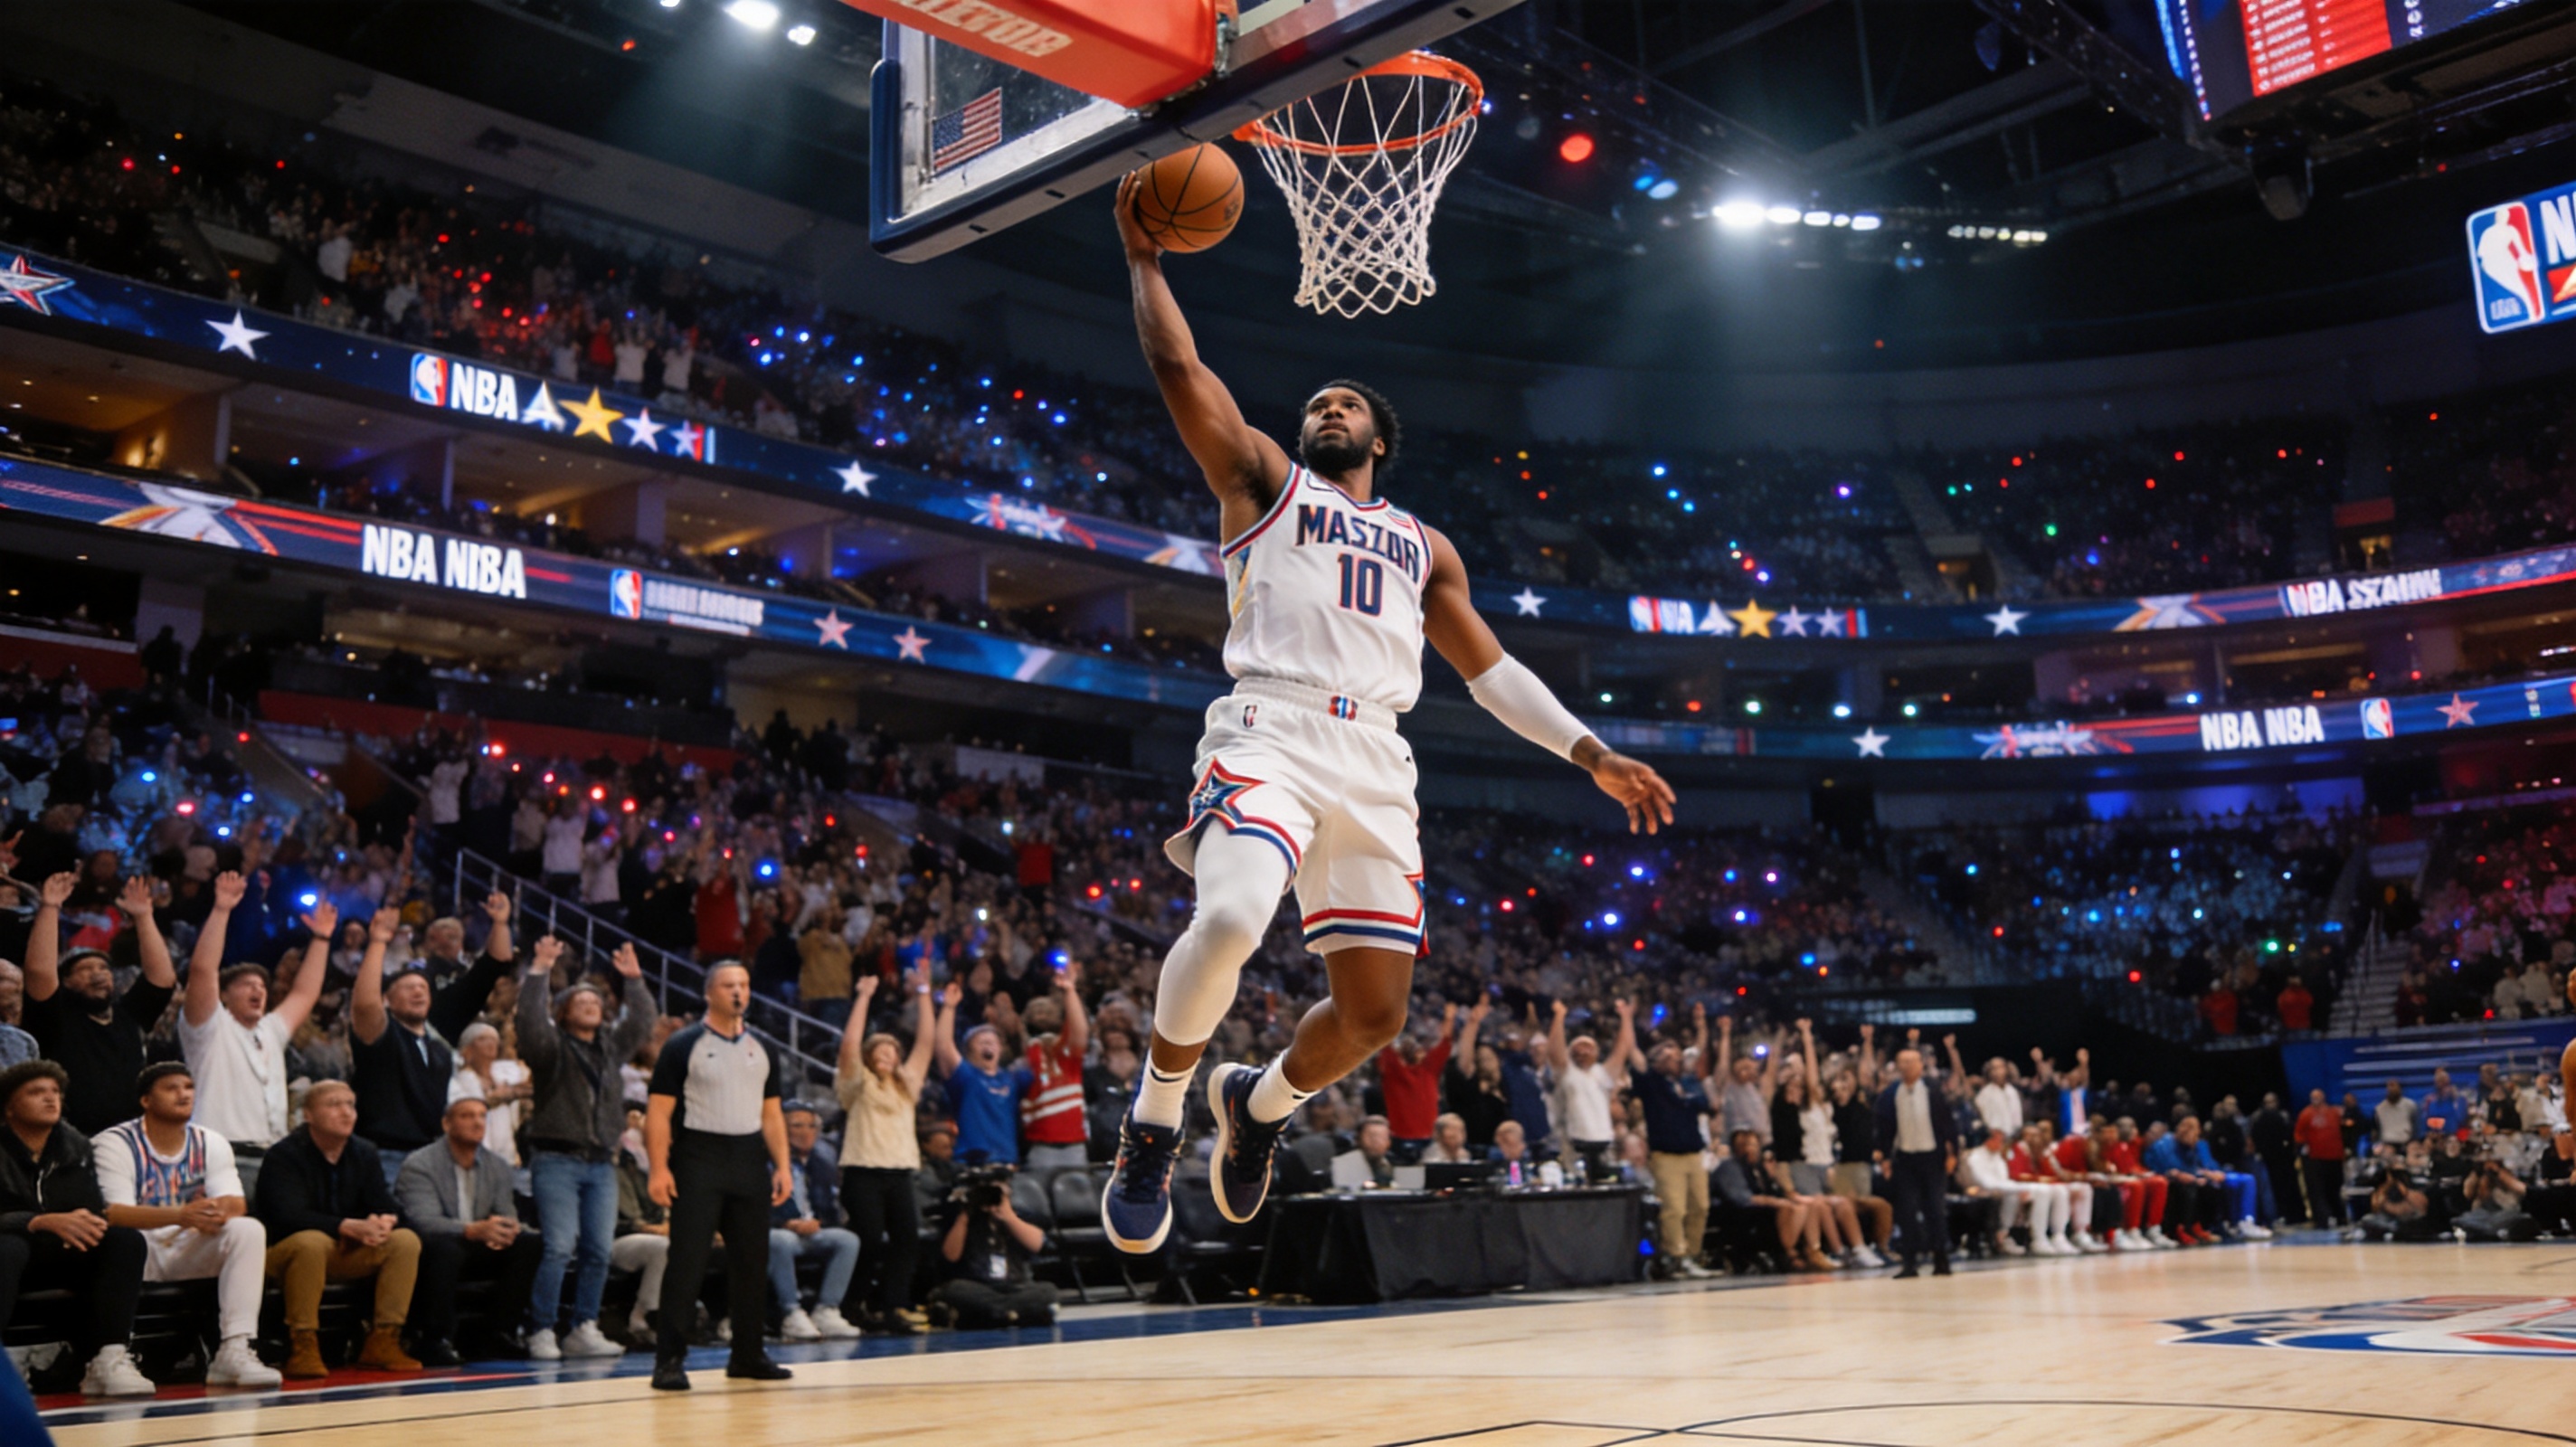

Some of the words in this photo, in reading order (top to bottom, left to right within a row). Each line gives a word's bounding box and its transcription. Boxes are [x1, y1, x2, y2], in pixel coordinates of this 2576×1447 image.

[2539, 190, 2576, 265] N
[451, 362, 517, 421] NBA
[362, 525, 439, 584] NBA
[1338, 553, 1384, 618] 10
[2287, 579, 2345, 617] NBA
[2200, 711, 2263, 751] NBA
[2264, 705, 2325, 745] NBA
